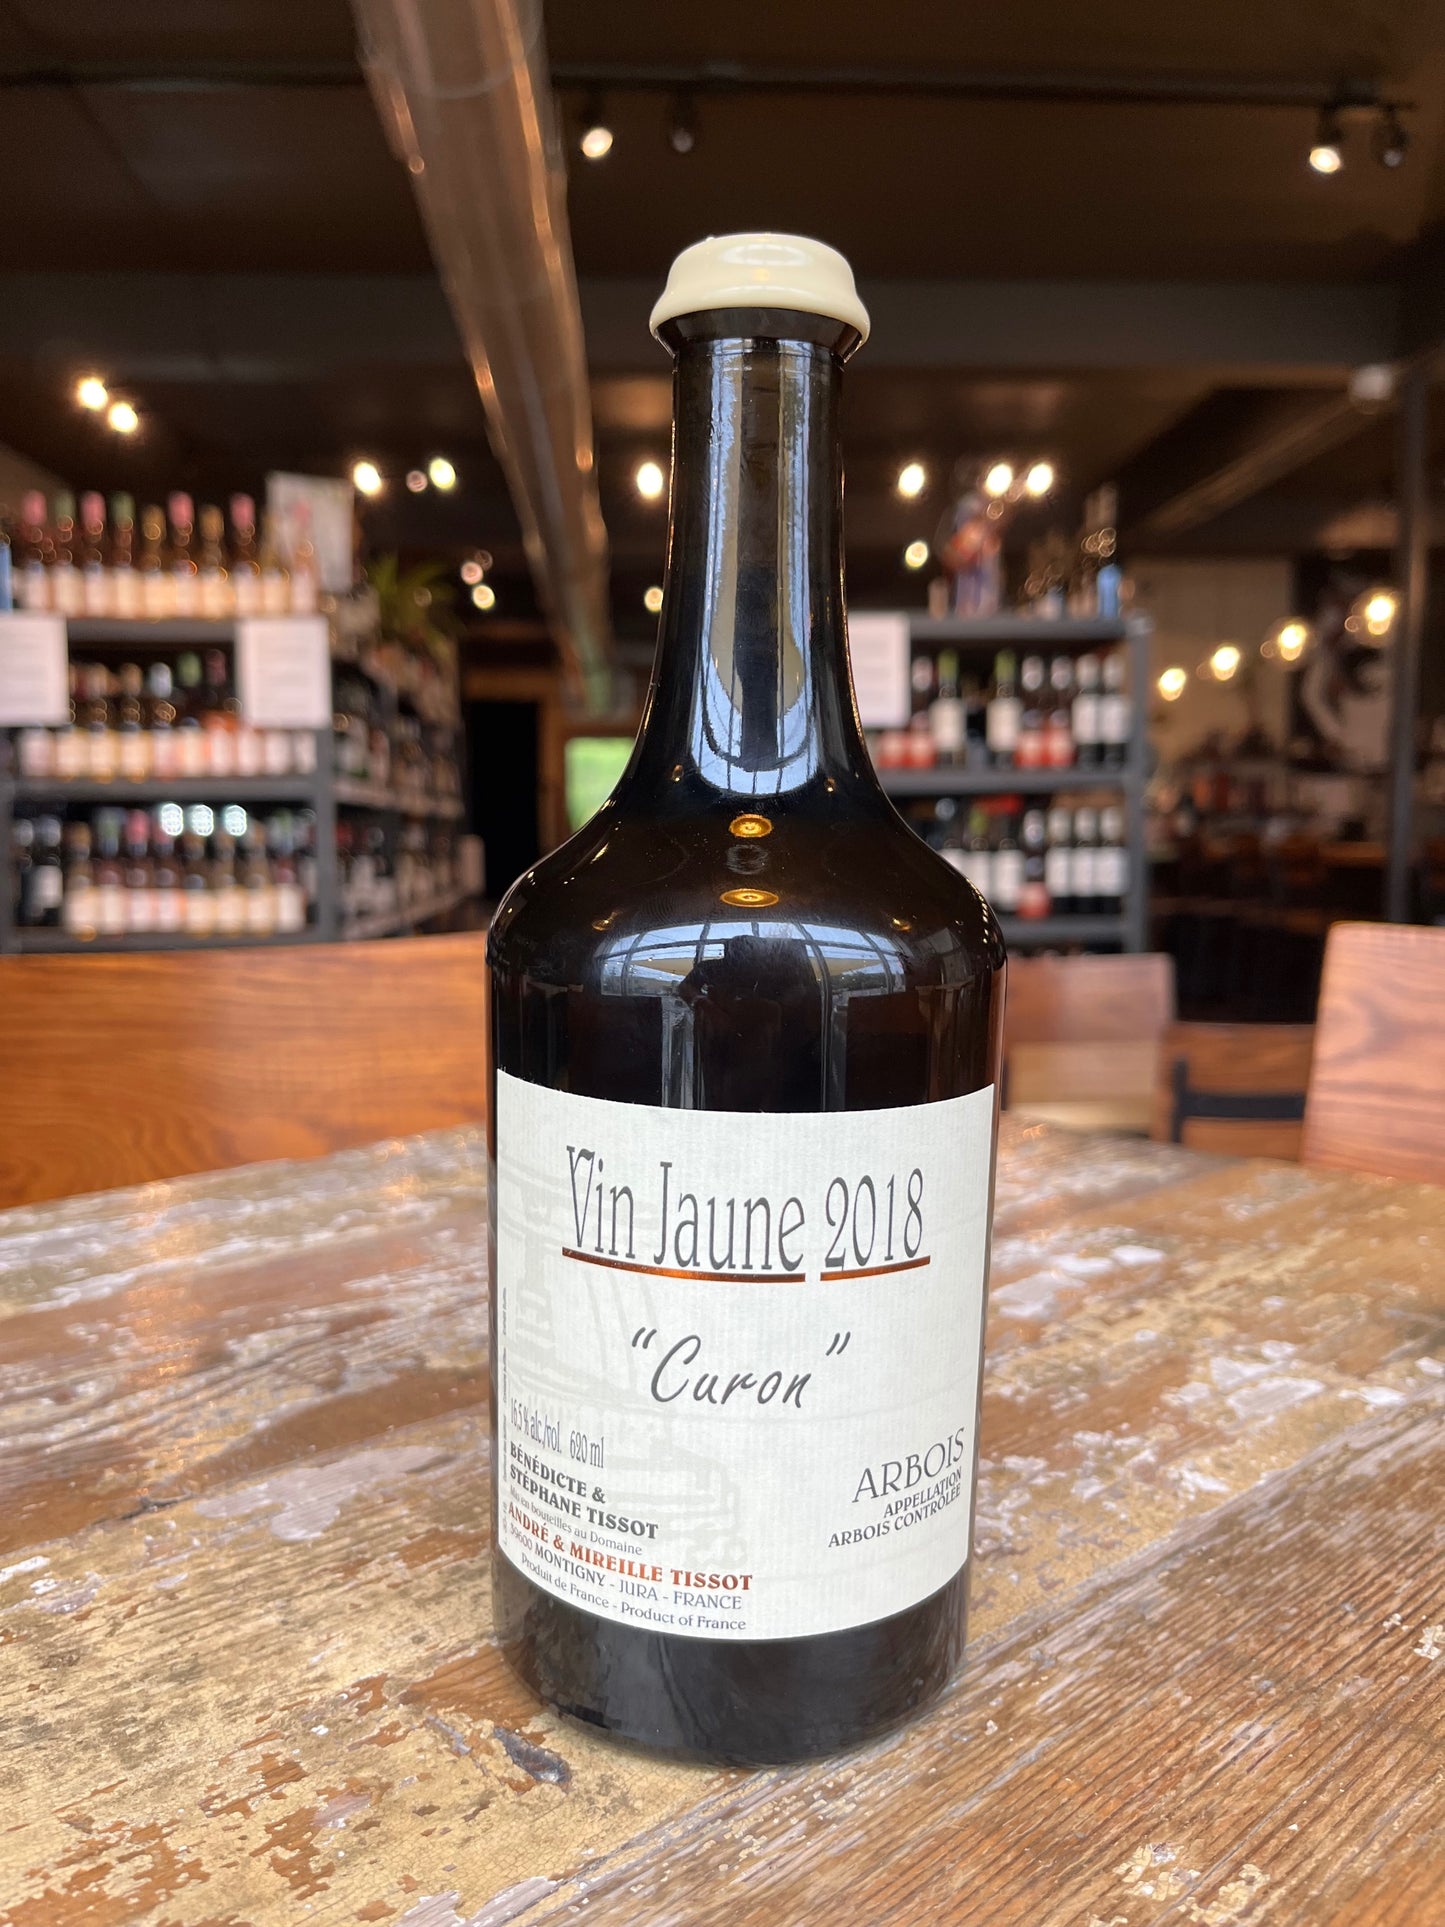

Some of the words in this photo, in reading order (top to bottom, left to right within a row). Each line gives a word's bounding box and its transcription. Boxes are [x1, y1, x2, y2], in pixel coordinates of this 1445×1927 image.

[566, 1145, 637, 1260] Vin
[654, 1161, 806, 1272] Jaune
[824, 1168, 925, 1271] 2018
[510, 1440, 587, 1498] BÉNÉDICTE
[591, 1486, 606, 1504] &
[569, 1430, 588, 1464] 620
[589, 1436, 605, 1469] ml
[852, 1427, 965, 1503] ARBOIS
[510, 1463, 582, 1519] STÉPHANE
[587, 1507, 659, 1540] TISSOT
[520, 1496, 530, 1509] en
[531, 1502, 572, 1533] bouteilles
[574, 1525, 587, 1540] au
[590, 1531, 643, 1556] Domaine
[883, 1466, 962, 1518] APPELLATION
[508, 1502, 549, 1543] ANDRÉ
[553, 1534, 565, 1552] &
[570, 1541, 663, 1582] MIREILLE
[670, 1568, 753, 1591] TISSOT
[510, 1524, 533, 1551] 39600
[535, 1542, 606, 1587] MONTIGNY
[619, 1579, 658, 1601] JURA
[673, 1591, 742, 1610] FRANCE
[828, 1521, 890, 1548] ARBOIS
[521, 1552, 552, 1583] Produit
[555, 1576, 567, 1591] de
[570, 1583, 609, 1609] France
[621, 1602, 675, 1625] Product
[679, 1614, 696, 1627] of
[697, 1616, 746, 1630] France
